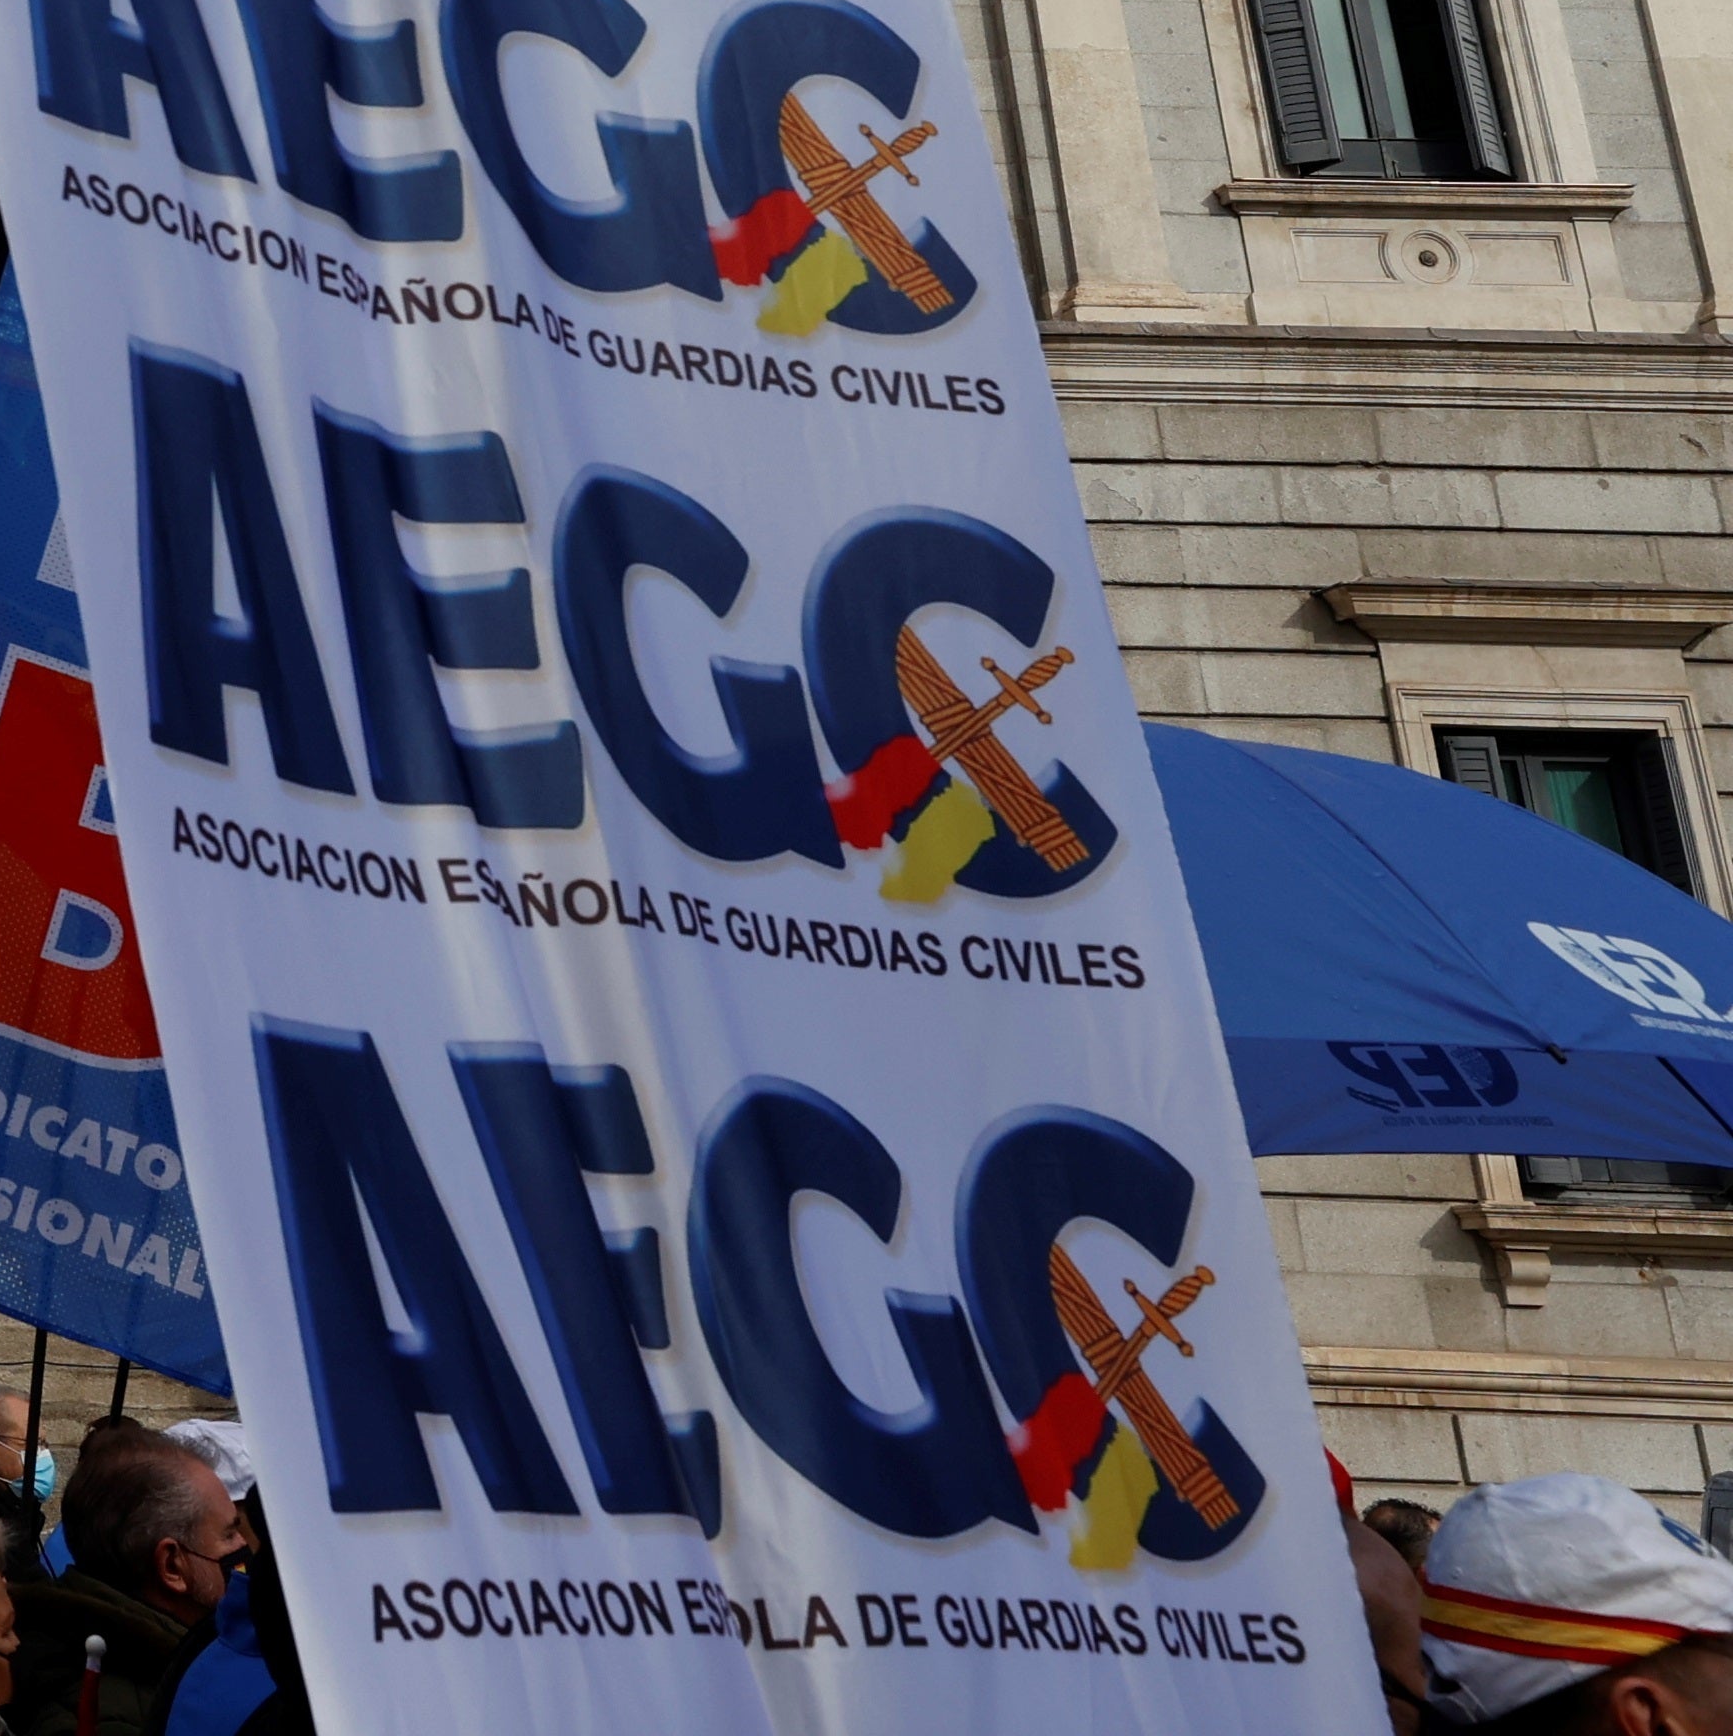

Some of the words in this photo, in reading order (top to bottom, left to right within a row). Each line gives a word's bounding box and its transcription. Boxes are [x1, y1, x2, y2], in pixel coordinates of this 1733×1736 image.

[62, 165, 309, 284] ASOCIACION
[316, 253, 540, 335] ESPAÑOLA
[542, 305, 581, 358] DE
[588, 329, 818, 399] GUARDIAS
[831, 363, 1007, 416] CIVILES
[128, 334, 1119, 900] AEGC
[173, 806, 427, 904] ASOCIACION
[437, 858, 666, 933] ESAÑOLA
[669, 891, 720, 946] DE
[724, 906, 949, 977] GUARDIAS
[960, 934, 1147, 989] CIVILES
[250, 1012, 1267, 1563] AEGC
[372, 1579, 675, 1642] ASOCIACION
[856, 1594, 929, 1647] DE
[935, 1594, 1148, 1656] GUARDIAS
[1155, 1605, 1307, 1664] CIVILES
